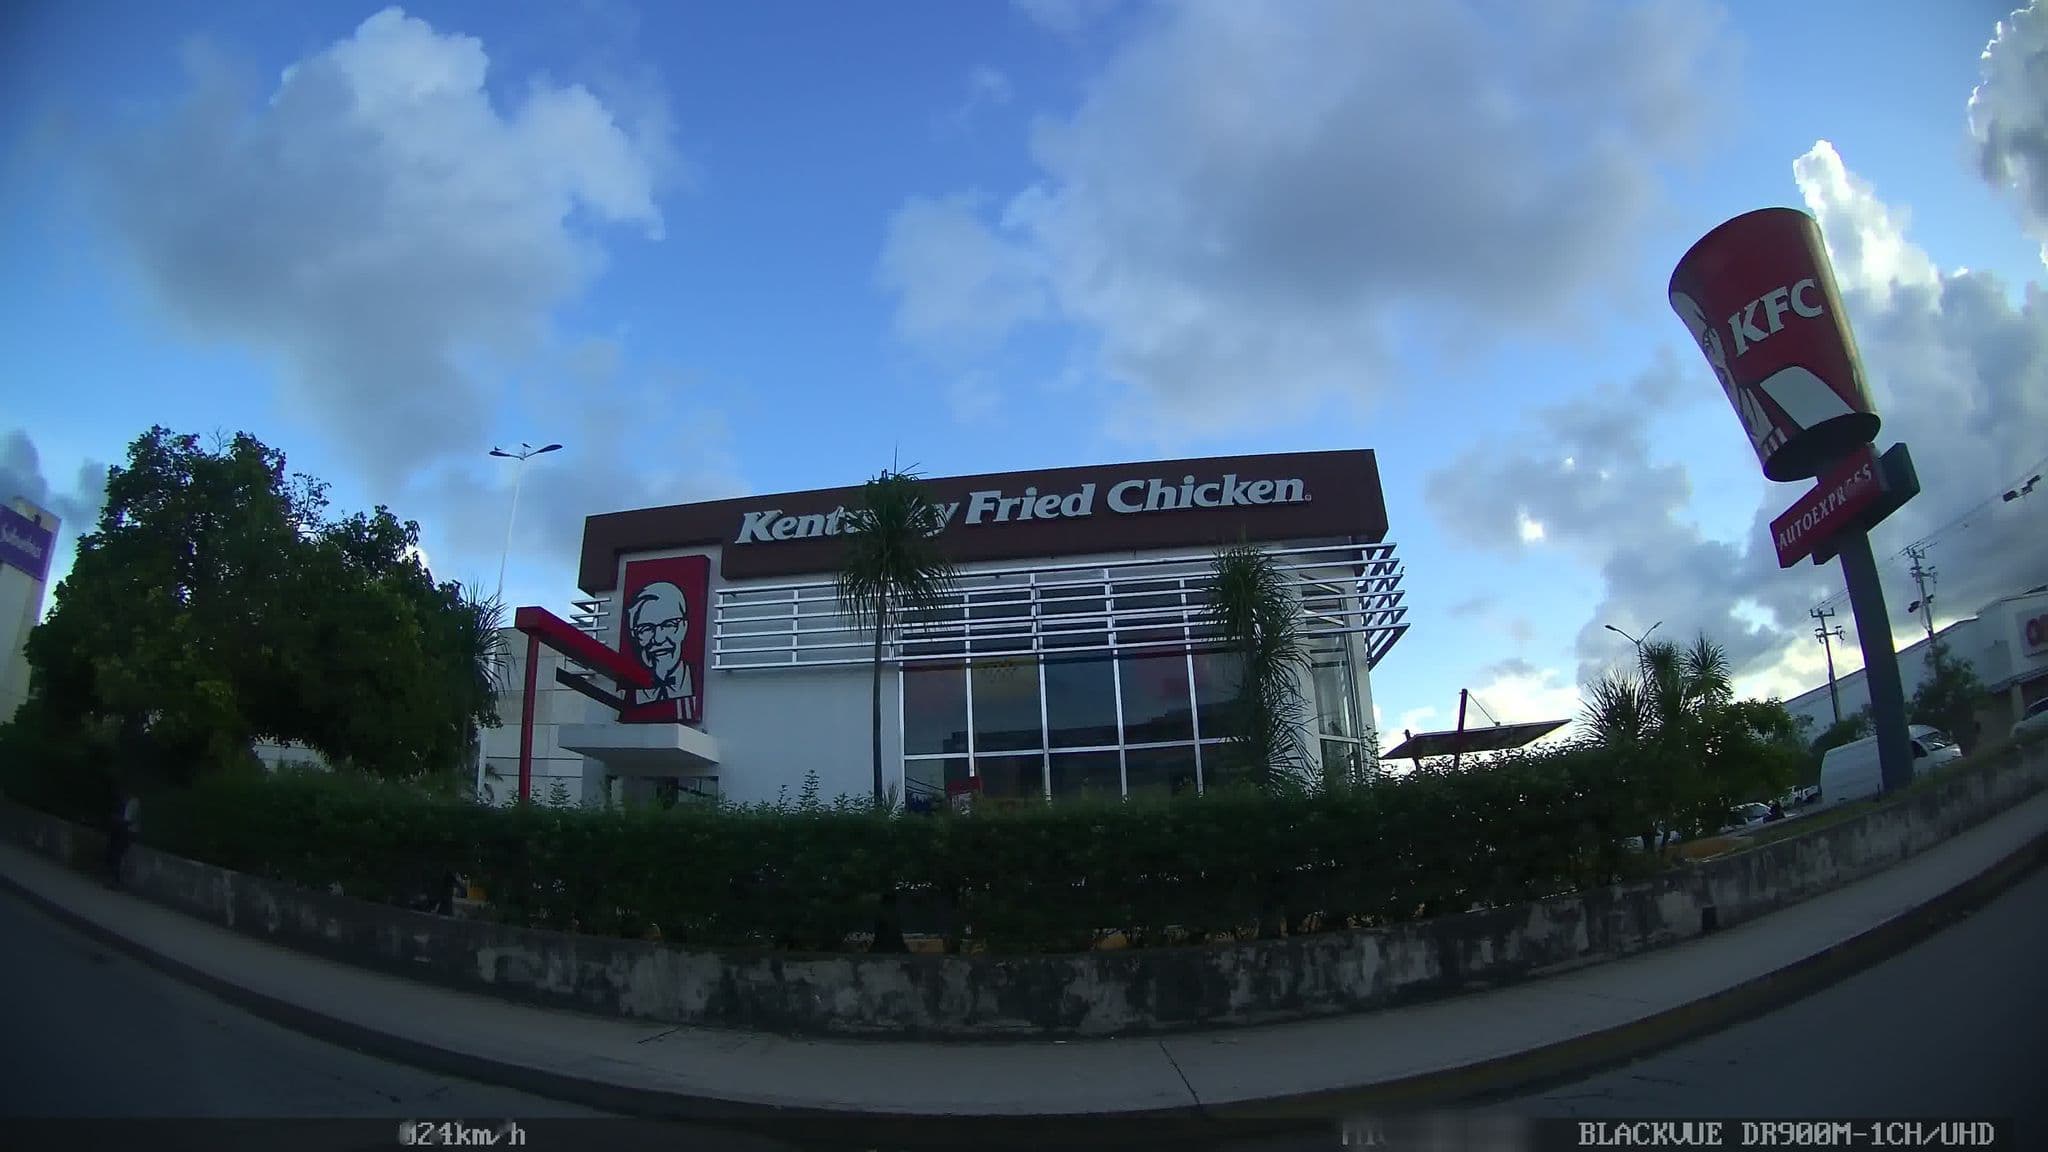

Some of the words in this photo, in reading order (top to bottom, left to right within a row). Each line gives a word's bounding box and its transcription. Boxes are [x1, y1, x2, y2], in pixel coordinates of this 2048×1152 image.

[1728, 278, 1823, 357] KFC
[734, 502, 960, 545] Kentuy
[965, 485, 1096, 524] Fried
[1106, 473, 1305, 513] Chicken
